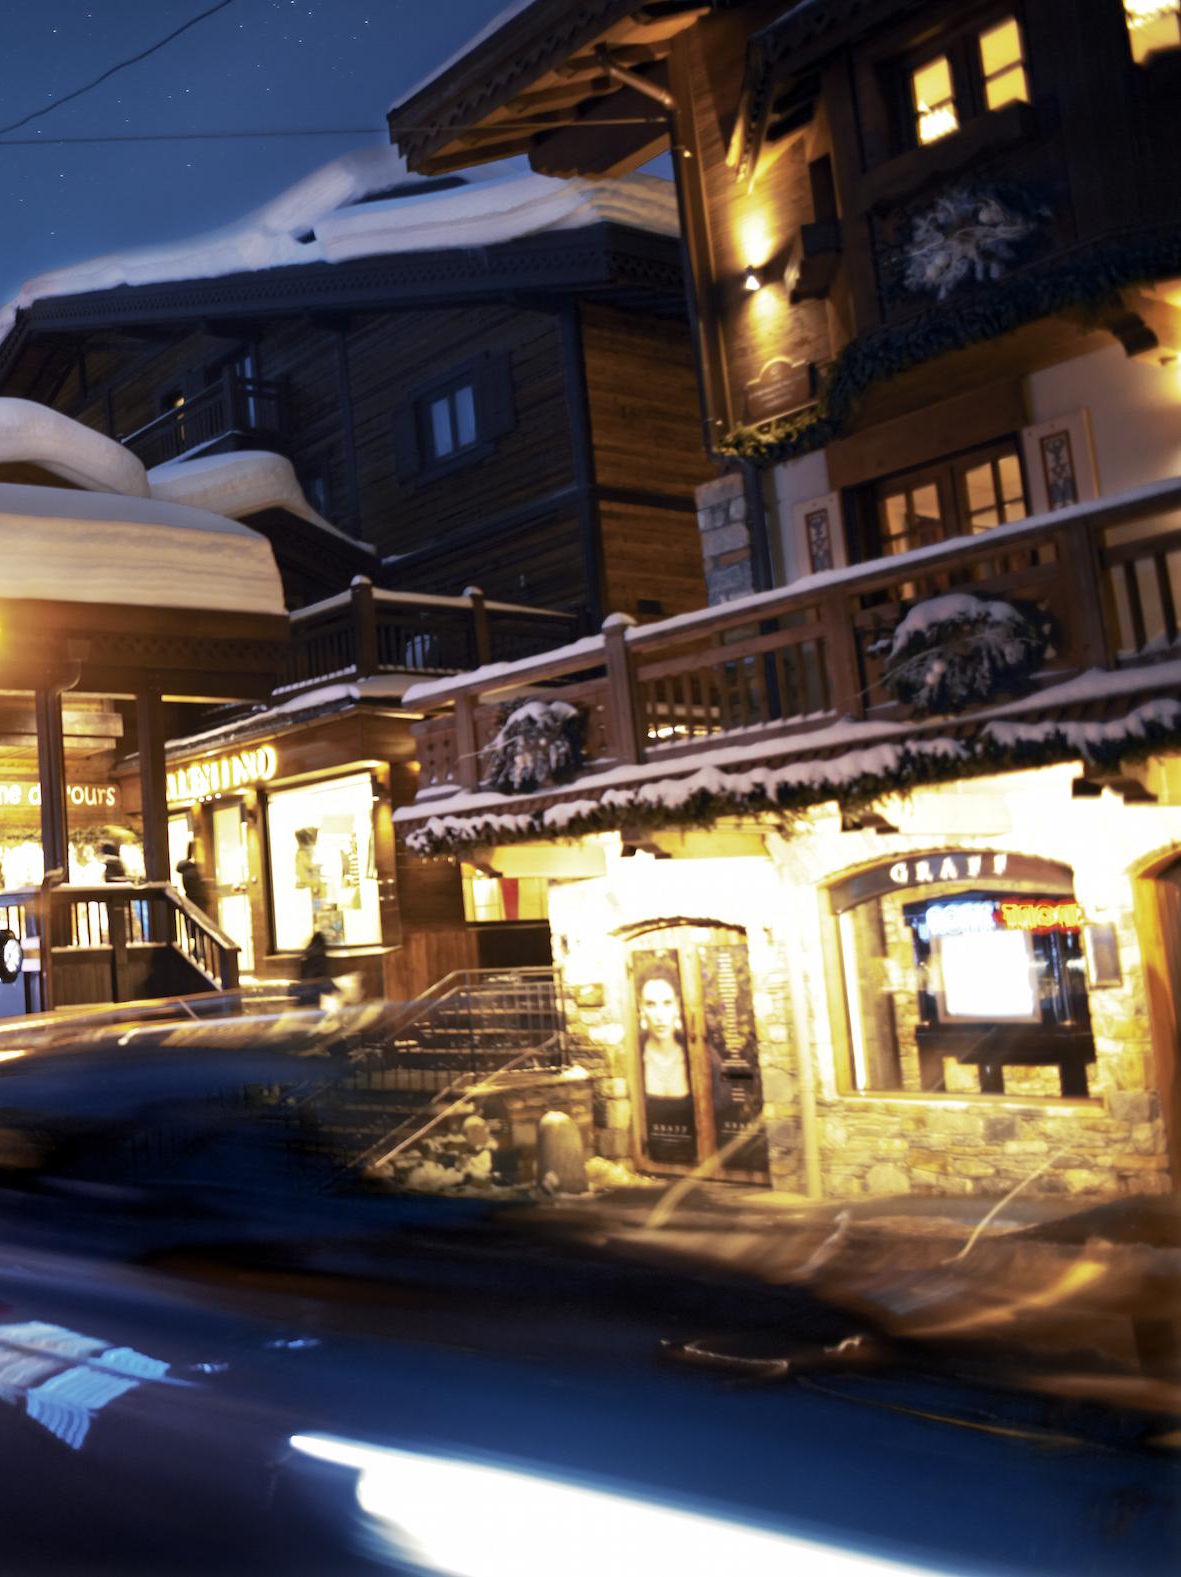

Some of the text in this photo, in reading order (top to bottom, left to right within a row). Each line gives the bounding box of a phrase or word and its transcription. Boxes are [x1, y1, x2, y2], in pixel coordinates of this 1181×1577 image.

[28, 782, 42, 806] d
[65, 784, 116, 806] 'ours
[889, 853, 1008, 884] GRAFF
